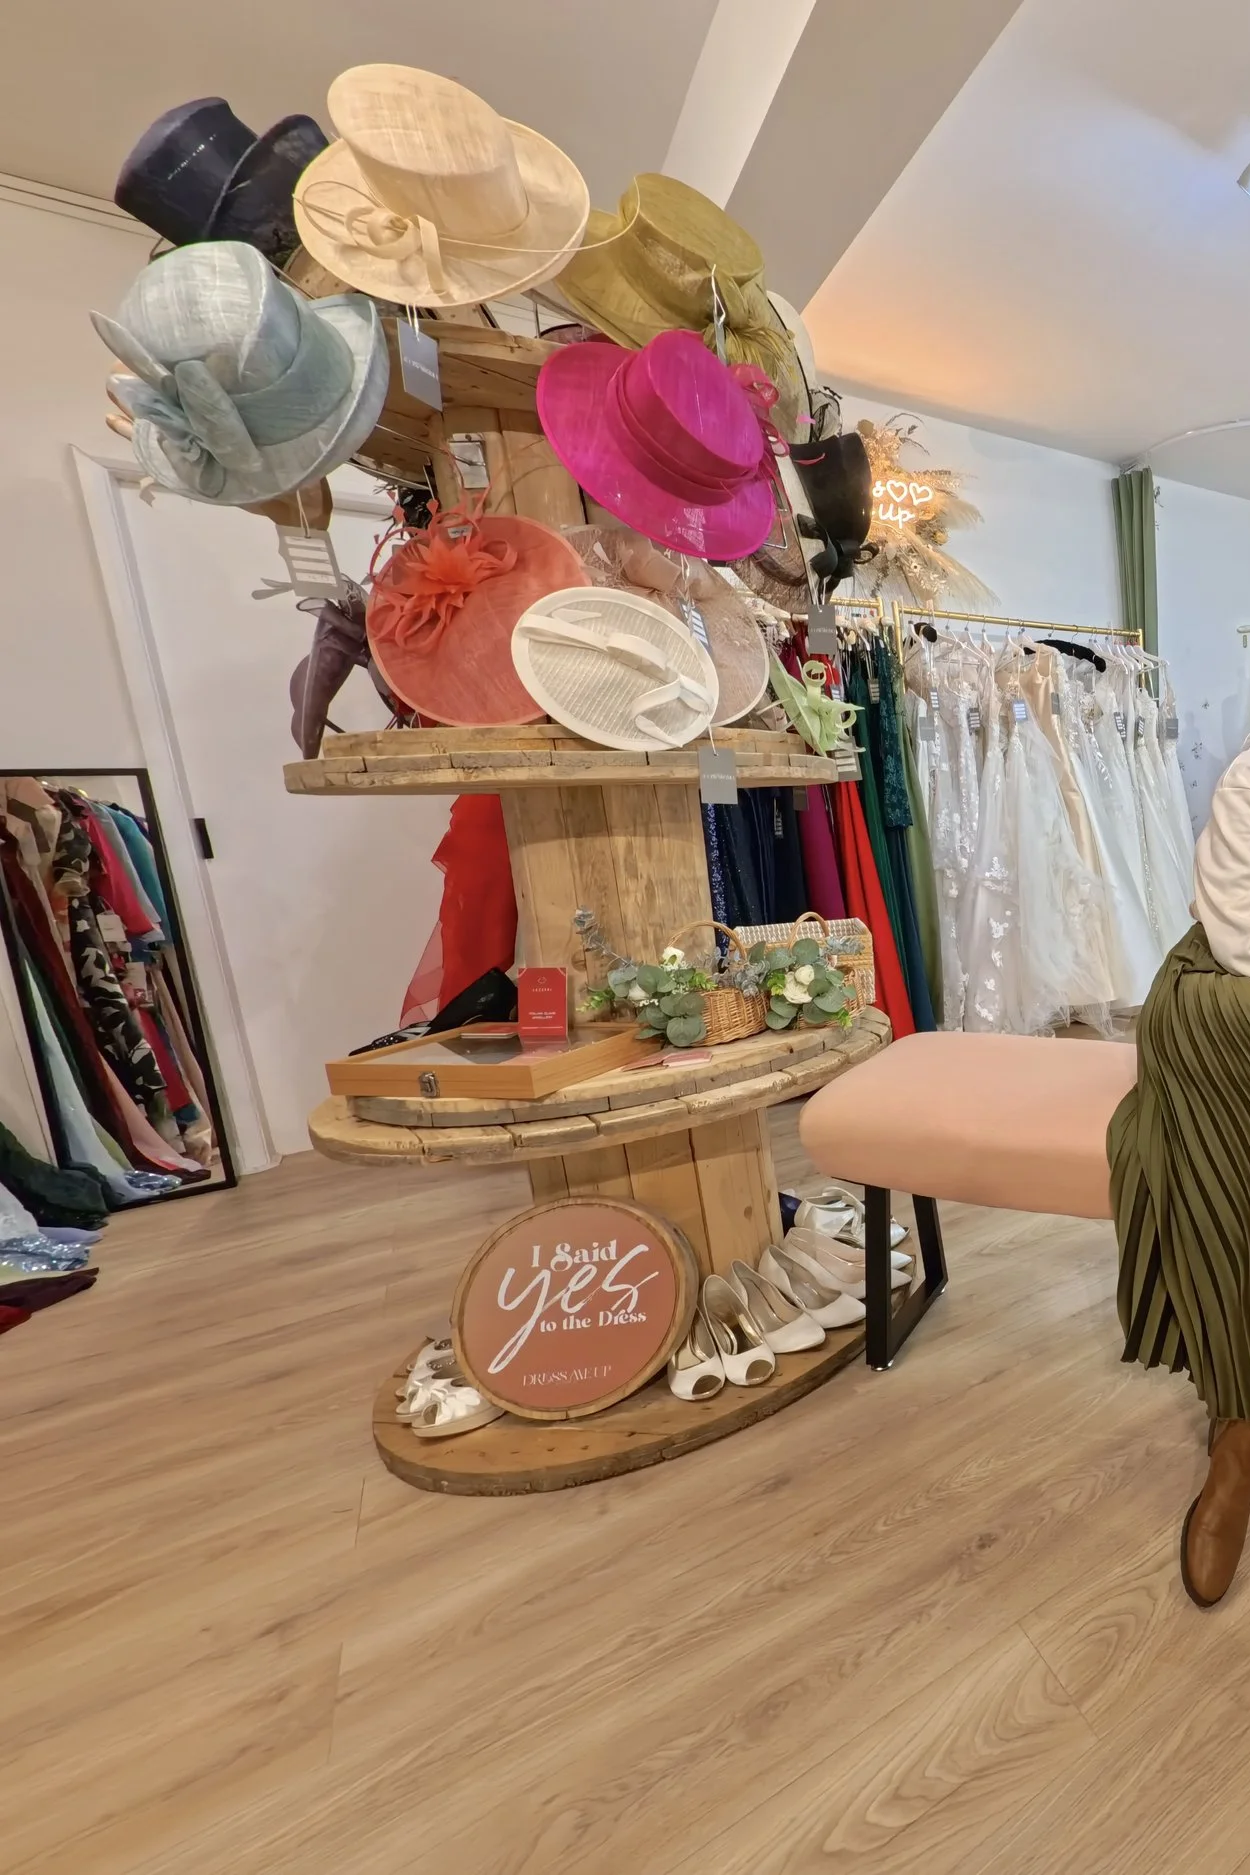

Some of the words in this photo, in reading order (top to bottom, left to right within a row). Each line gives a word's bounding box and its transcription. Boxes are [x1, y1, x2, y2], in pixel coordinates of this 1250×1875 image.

[879, 503, 915, 529] Up
[531, 1245, 541, 1267] I
[551, 1239, 617, 1272] Said
[487, 1244, 659, 1374] yes
[540, 1319, 557, 1333] to
[562, 1315, 591, 1330] the
[598, 1309, 647, 1327] Dress
[523, 1371, 568, 1387] DRESS
[594, 1364, 612, 1378] UP
